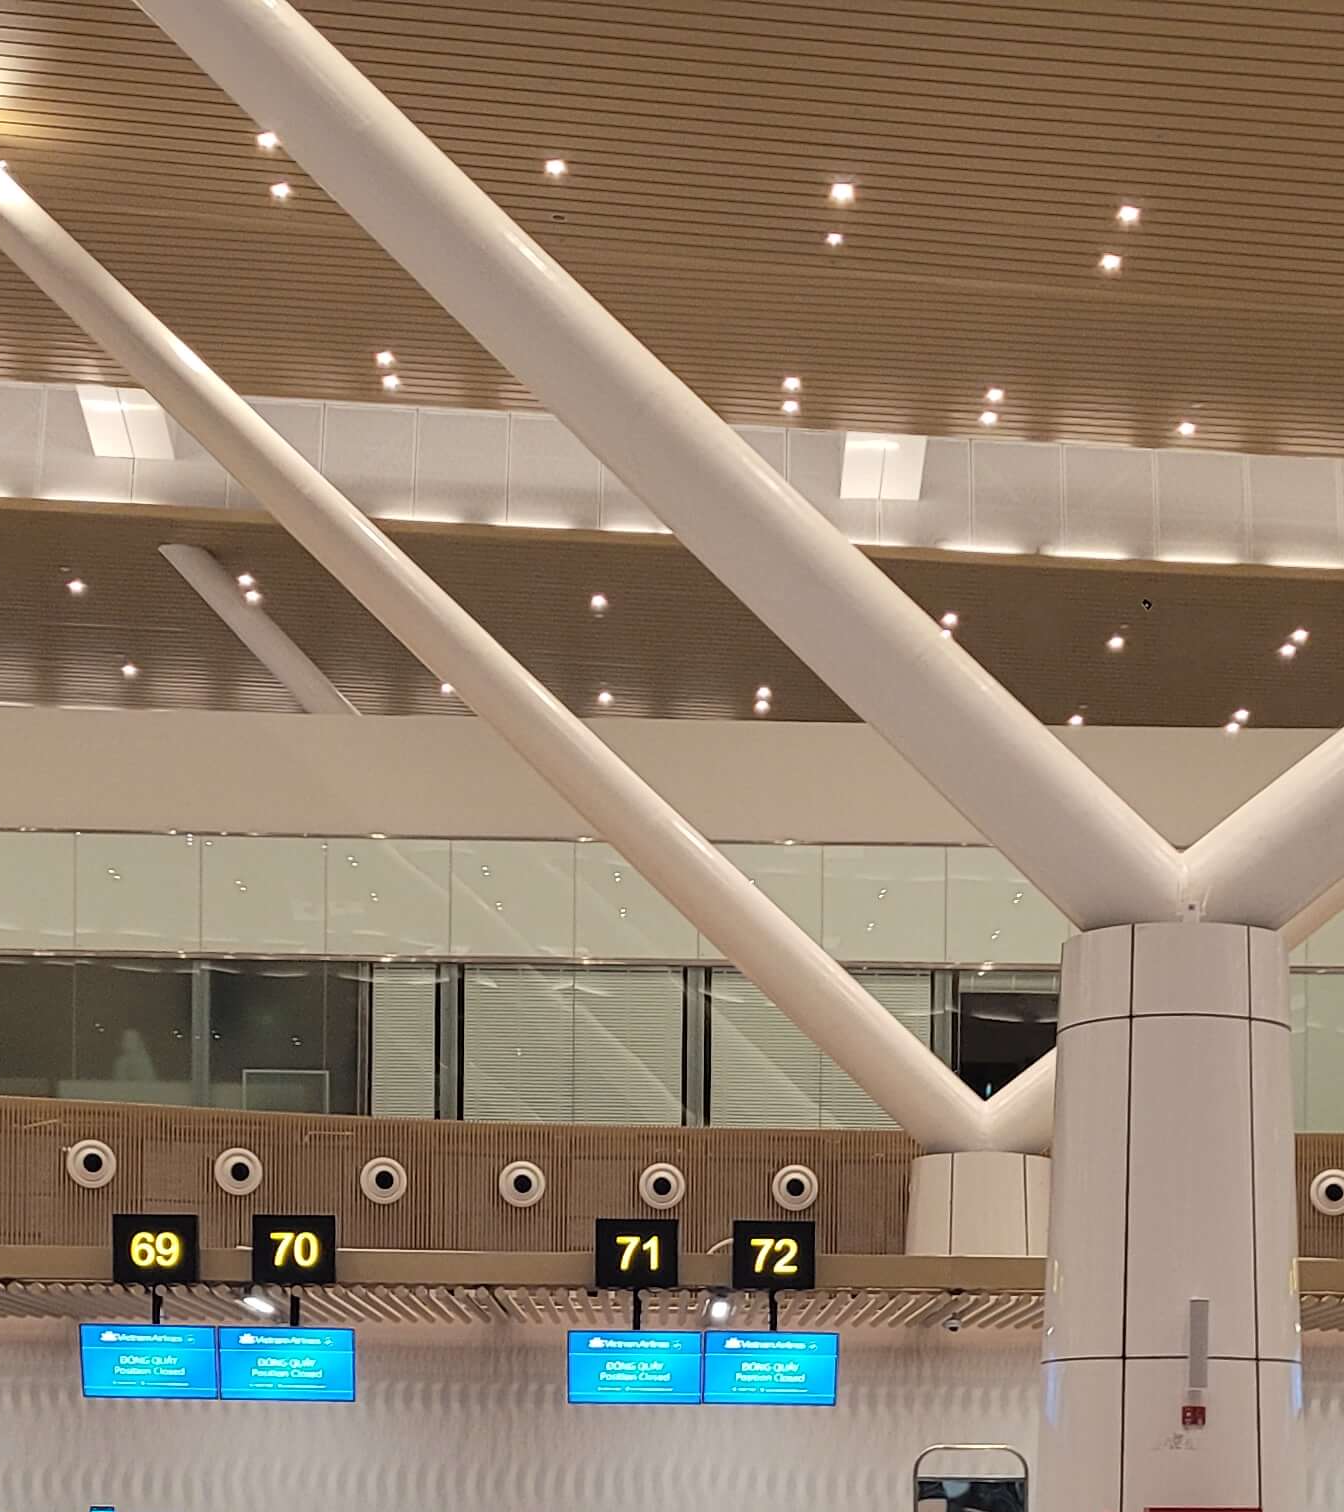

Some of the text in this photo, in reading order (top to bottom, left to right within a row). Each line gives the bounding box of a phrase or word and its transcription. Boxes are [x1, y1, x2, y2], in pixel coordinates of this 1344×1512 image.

[130, 1231, 181, 1267] 69
[270, 1231, 319, 1267] 70
[615, 1235, 660, 1271] 71
[750, 1238, 798, 1273] 72
